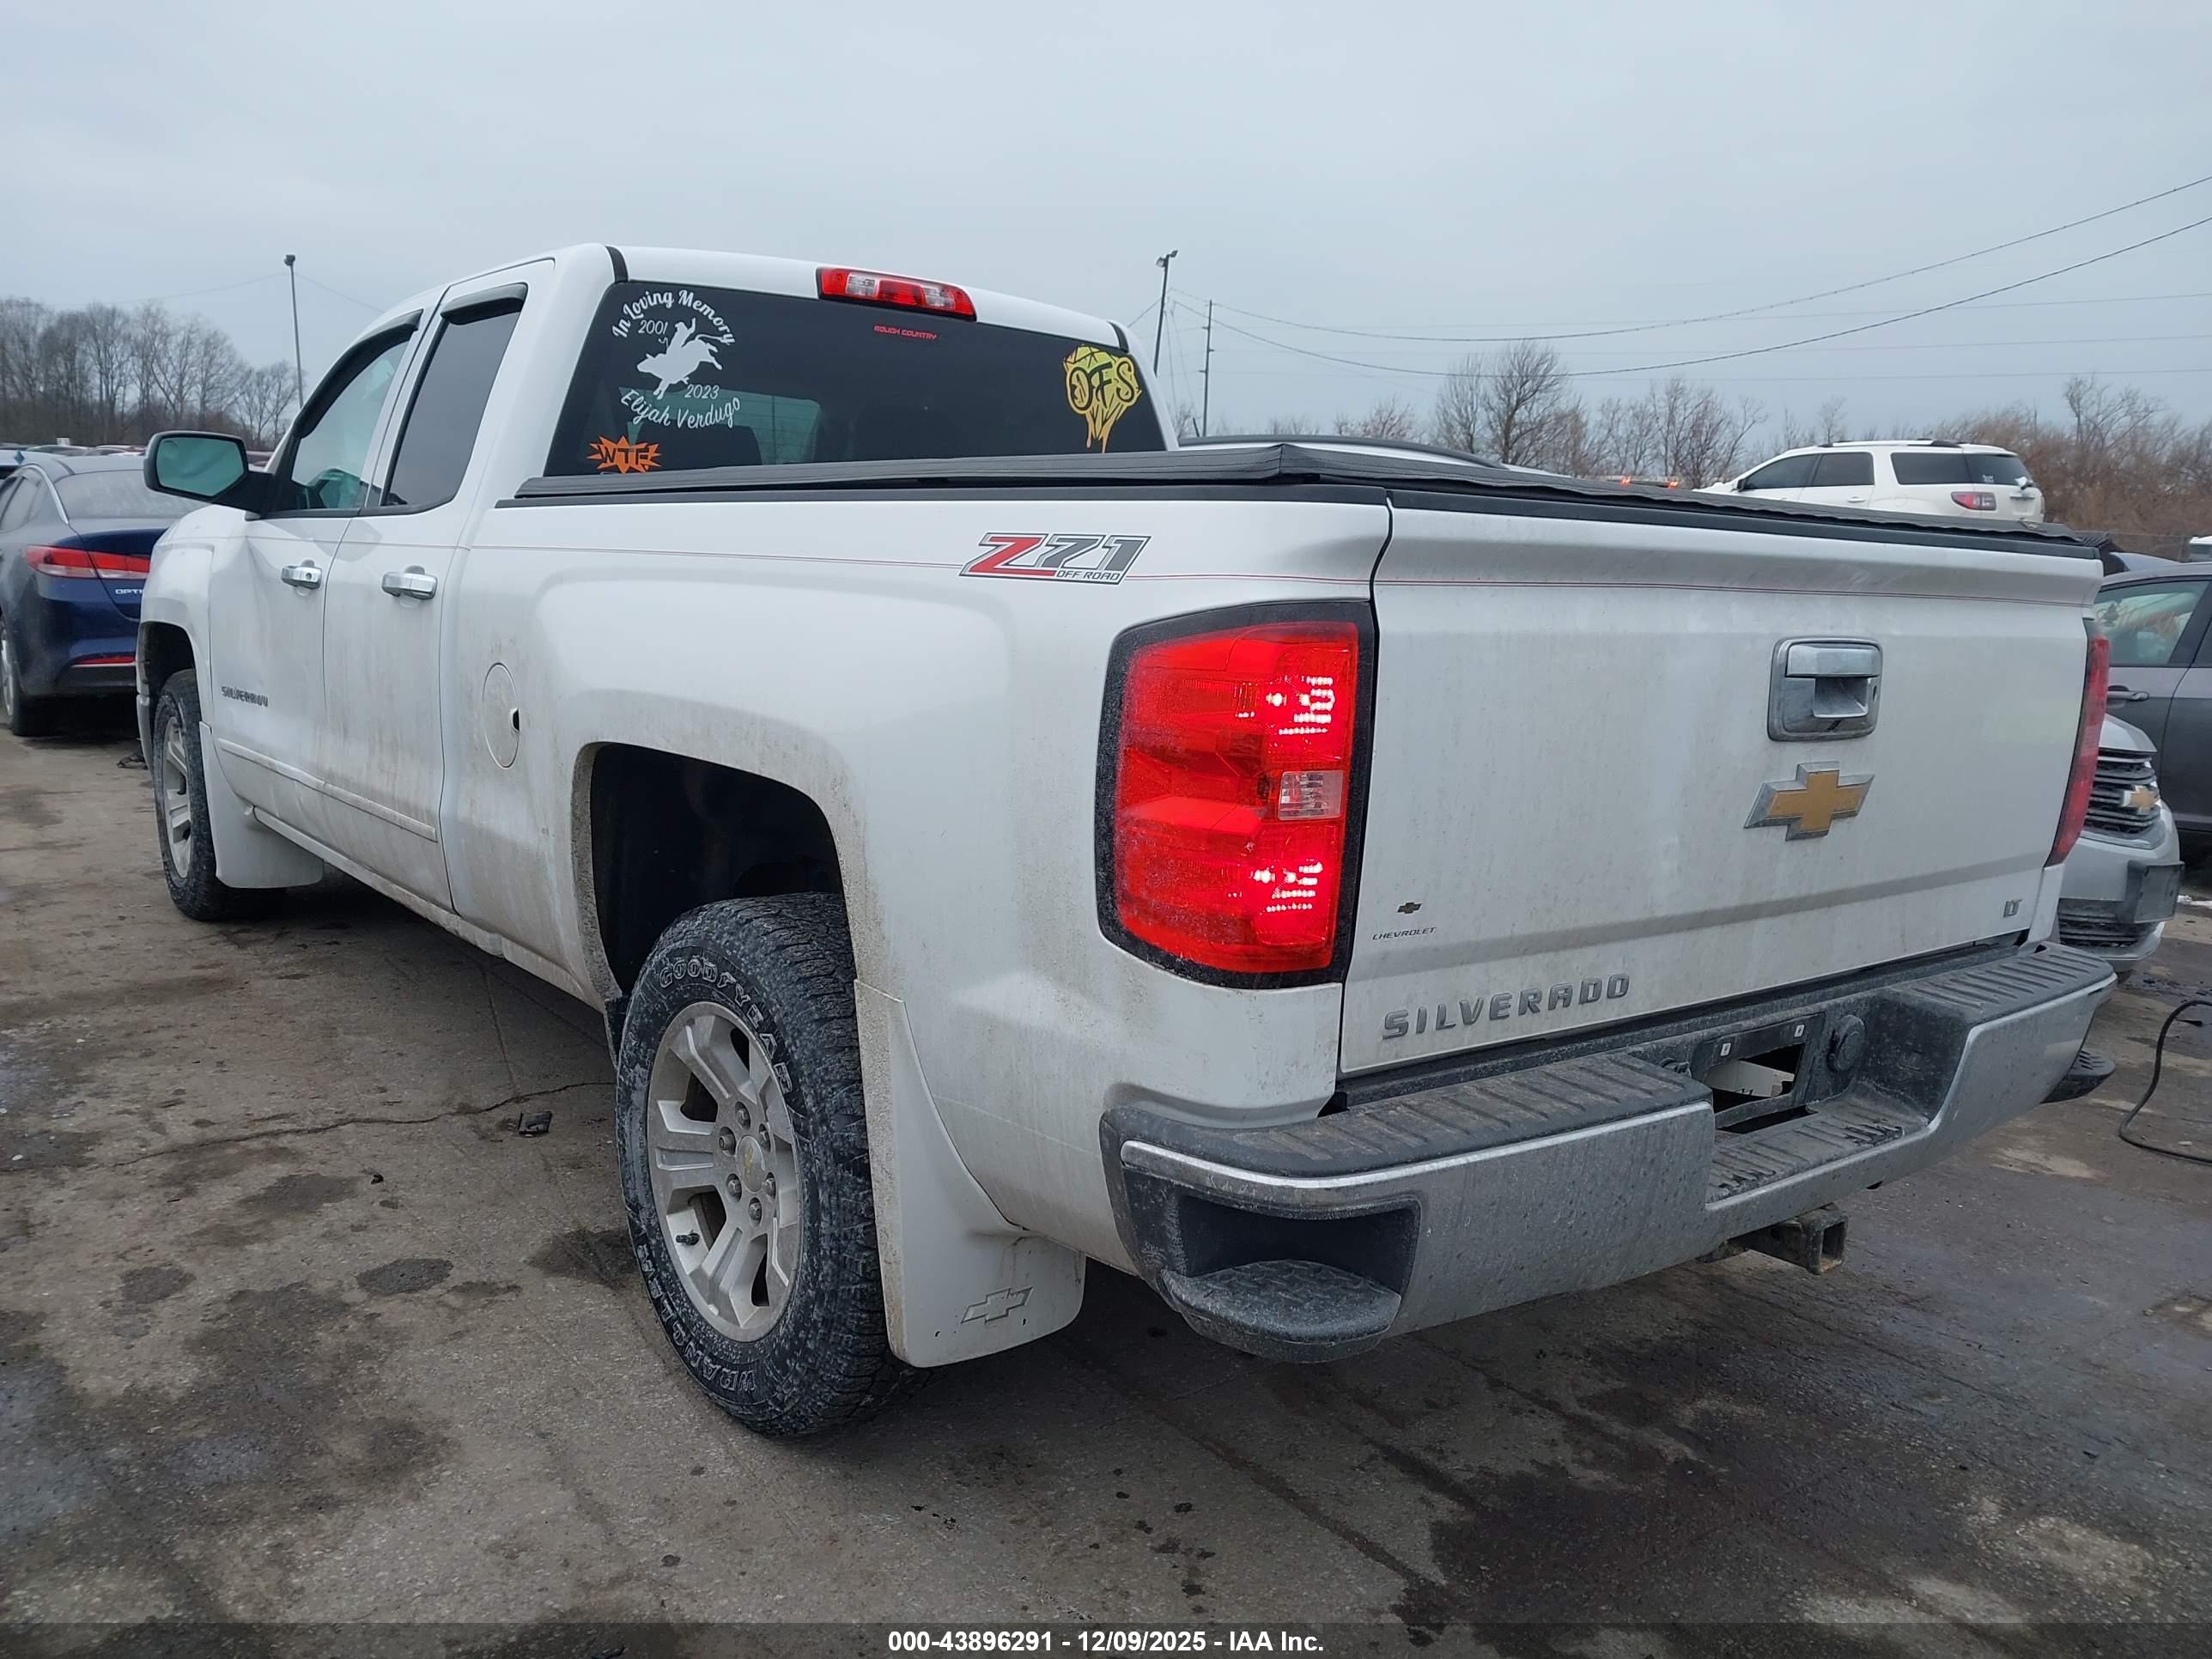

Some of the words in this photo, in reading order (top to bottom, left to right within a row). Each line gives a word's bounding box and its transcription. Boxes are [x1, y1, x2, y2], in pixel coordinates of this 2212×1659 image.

[612, 319, 631, 338] In
[623, 290, 674, 320] Loving
[678, 289, 735, 345] Memory
[638, 319, 668, 335] 2001
[874, 325, 901, 335] ROUGH
[901, 329, 937, 340] COUNTRY
[684, 384, 720, 399] 2023
[620, 388, 672, 427] Elijah
[676, 397, 740, 429] Verdugo
[959, 532, 1152, 585] Z71
[1056, 569, 1084, 580] OFF
[1083, 571, 1122, 581] ROAD
[1372, 926, 1437, 941] CHEVROLET
[1382, 972, 1631, 1041] SILVERADO
[659, 957, 793, 1095] GOODYEAR
